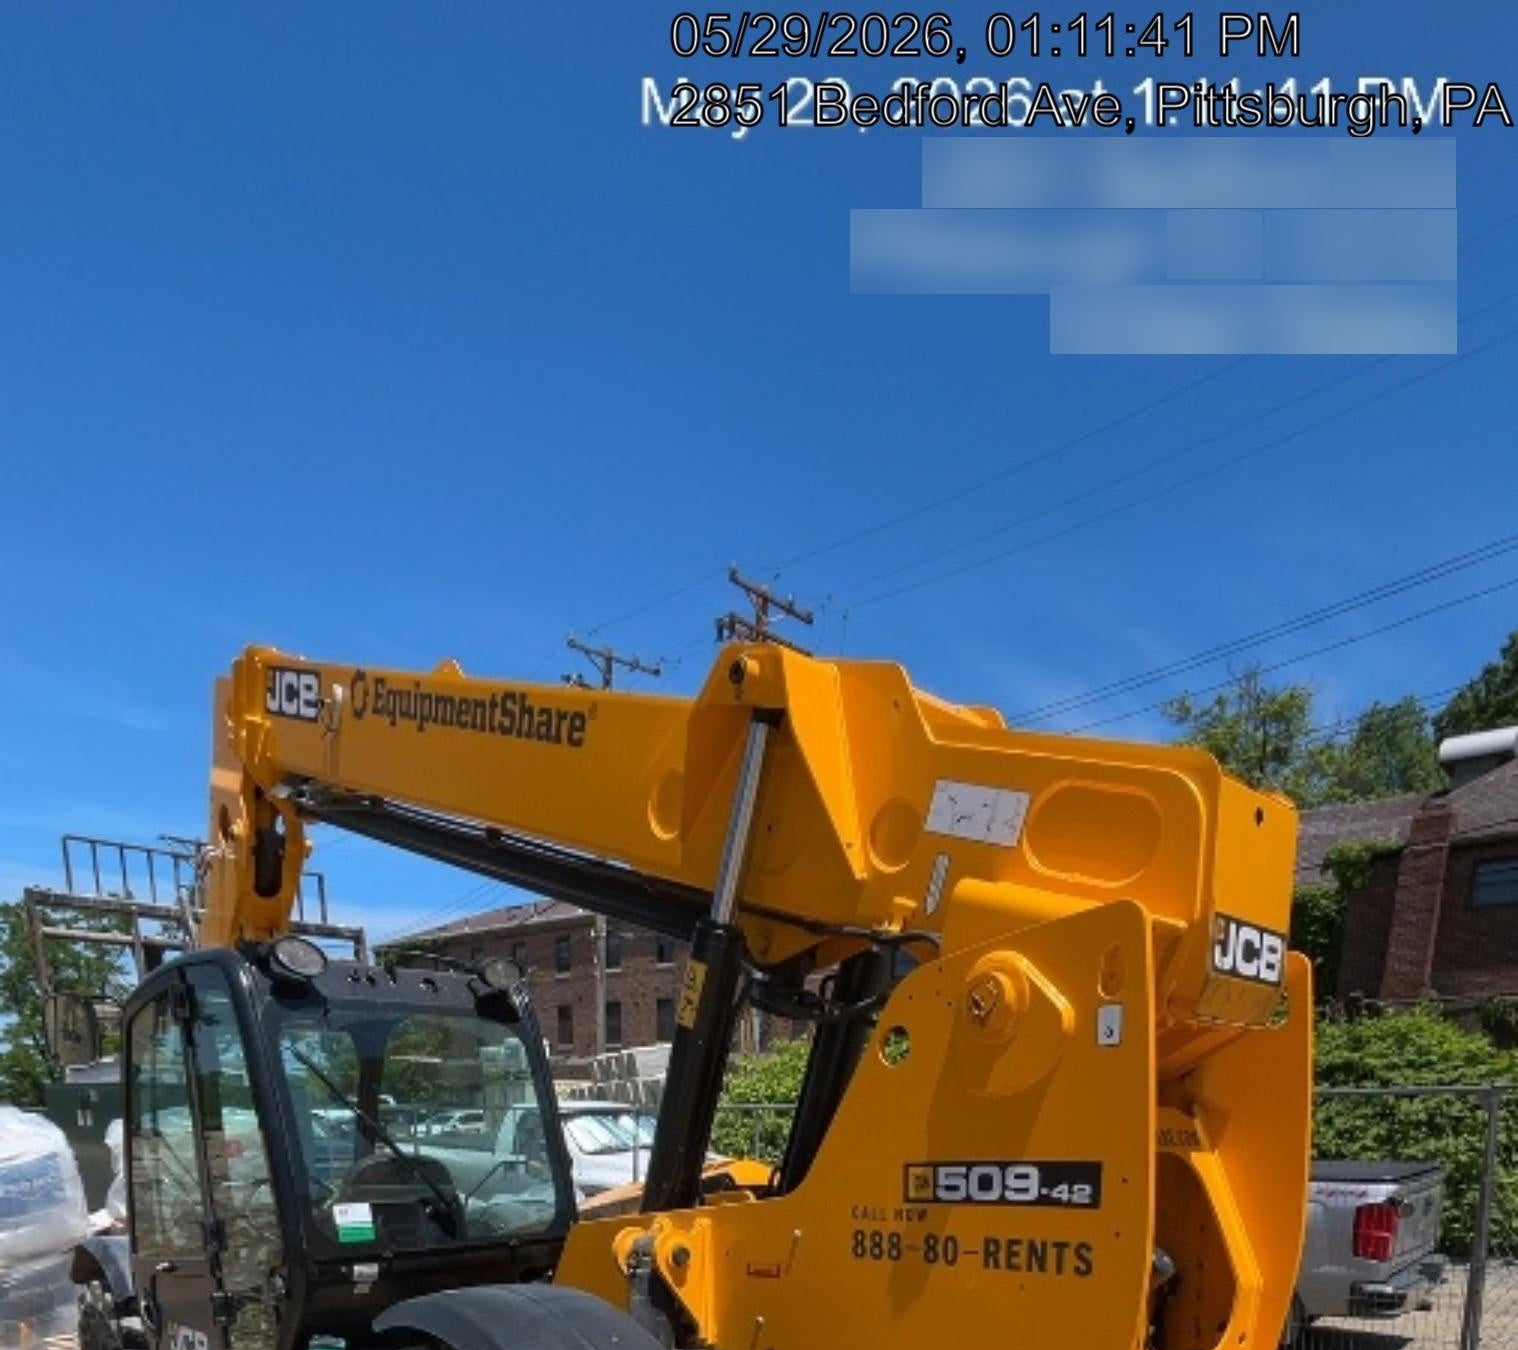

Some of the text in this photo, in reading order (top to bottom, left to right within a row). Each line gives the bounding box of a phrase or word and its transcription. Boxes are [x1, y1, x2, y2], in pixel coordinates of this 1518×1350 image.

[266, 670, 321, 718] JCB
[371, 677, 587, 748] EquipmentShare
[1213, 918, 1284, 984] JCB
[936, 1164, 1094, 1205] 509-42
[850, 1205, 888, 1221] CALL
[852, 1228, 1094, 1278] 888-80-RENTS
